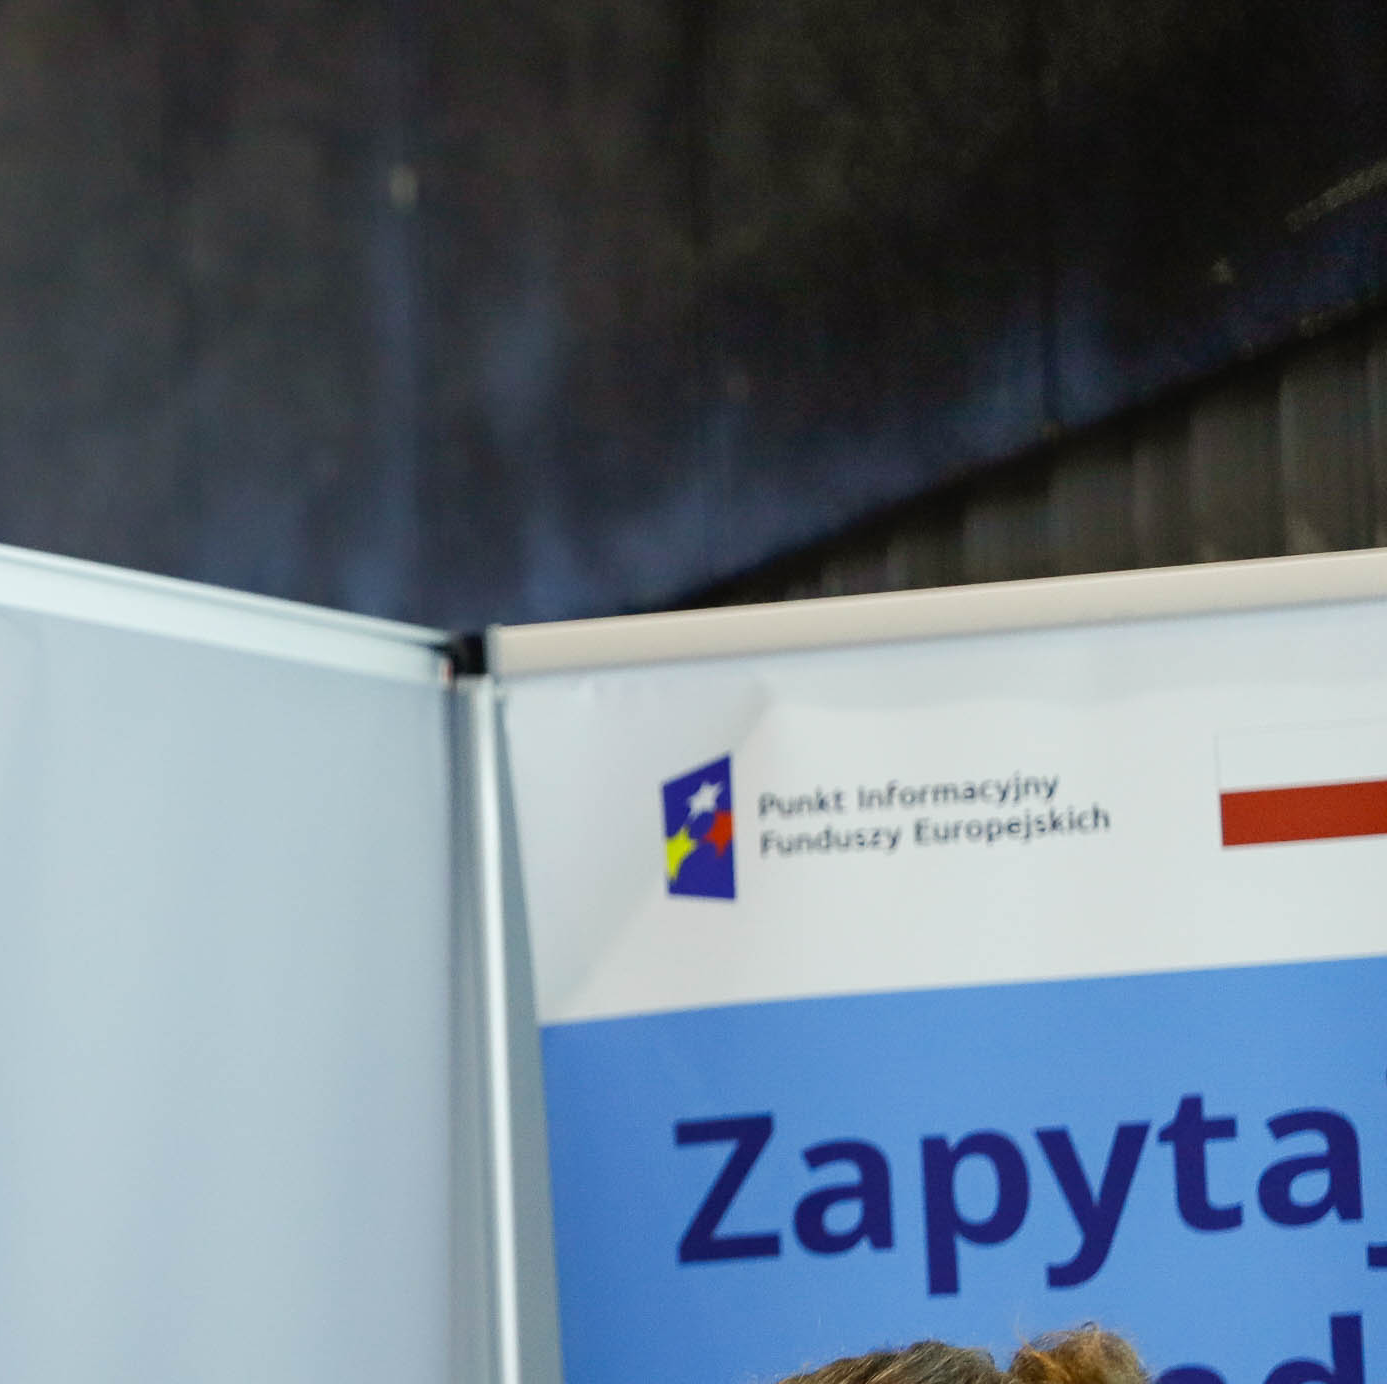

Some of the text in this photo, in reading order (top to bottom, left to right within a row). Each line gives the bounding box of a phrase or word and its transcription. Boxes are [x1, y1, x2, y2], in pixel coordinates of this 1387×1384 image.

[758, 771, 1059, 817] Punkt Informacyjny
[760, 802, 1111, 858] Funduszy Europejskich
[673, 1094, 1387, 1296] Zapyta
